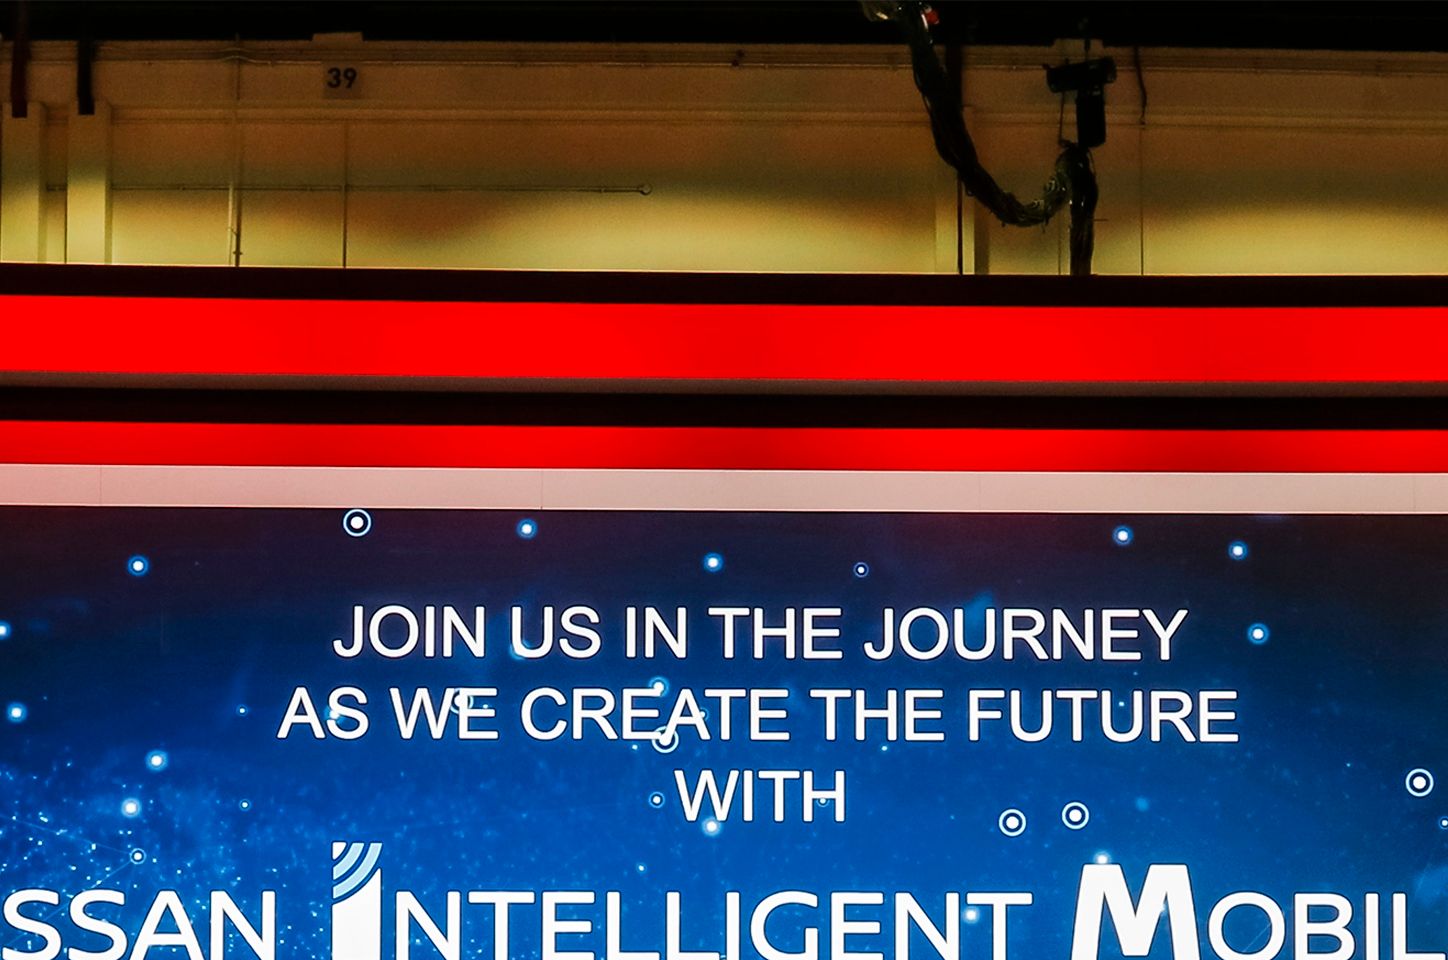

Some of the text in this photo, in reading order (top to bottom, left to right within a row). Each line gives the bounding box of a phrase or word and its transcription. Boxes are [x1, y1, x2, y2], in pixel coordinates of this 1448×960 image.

[327, 67, 357, 89] 39
[333, 606, 1188, 661] JOIN US IN THE JOURNEY
[277, 687, 1239, 746] AS WE CREATE THE FUTURE
[674, 770, 845, 823] WITH
